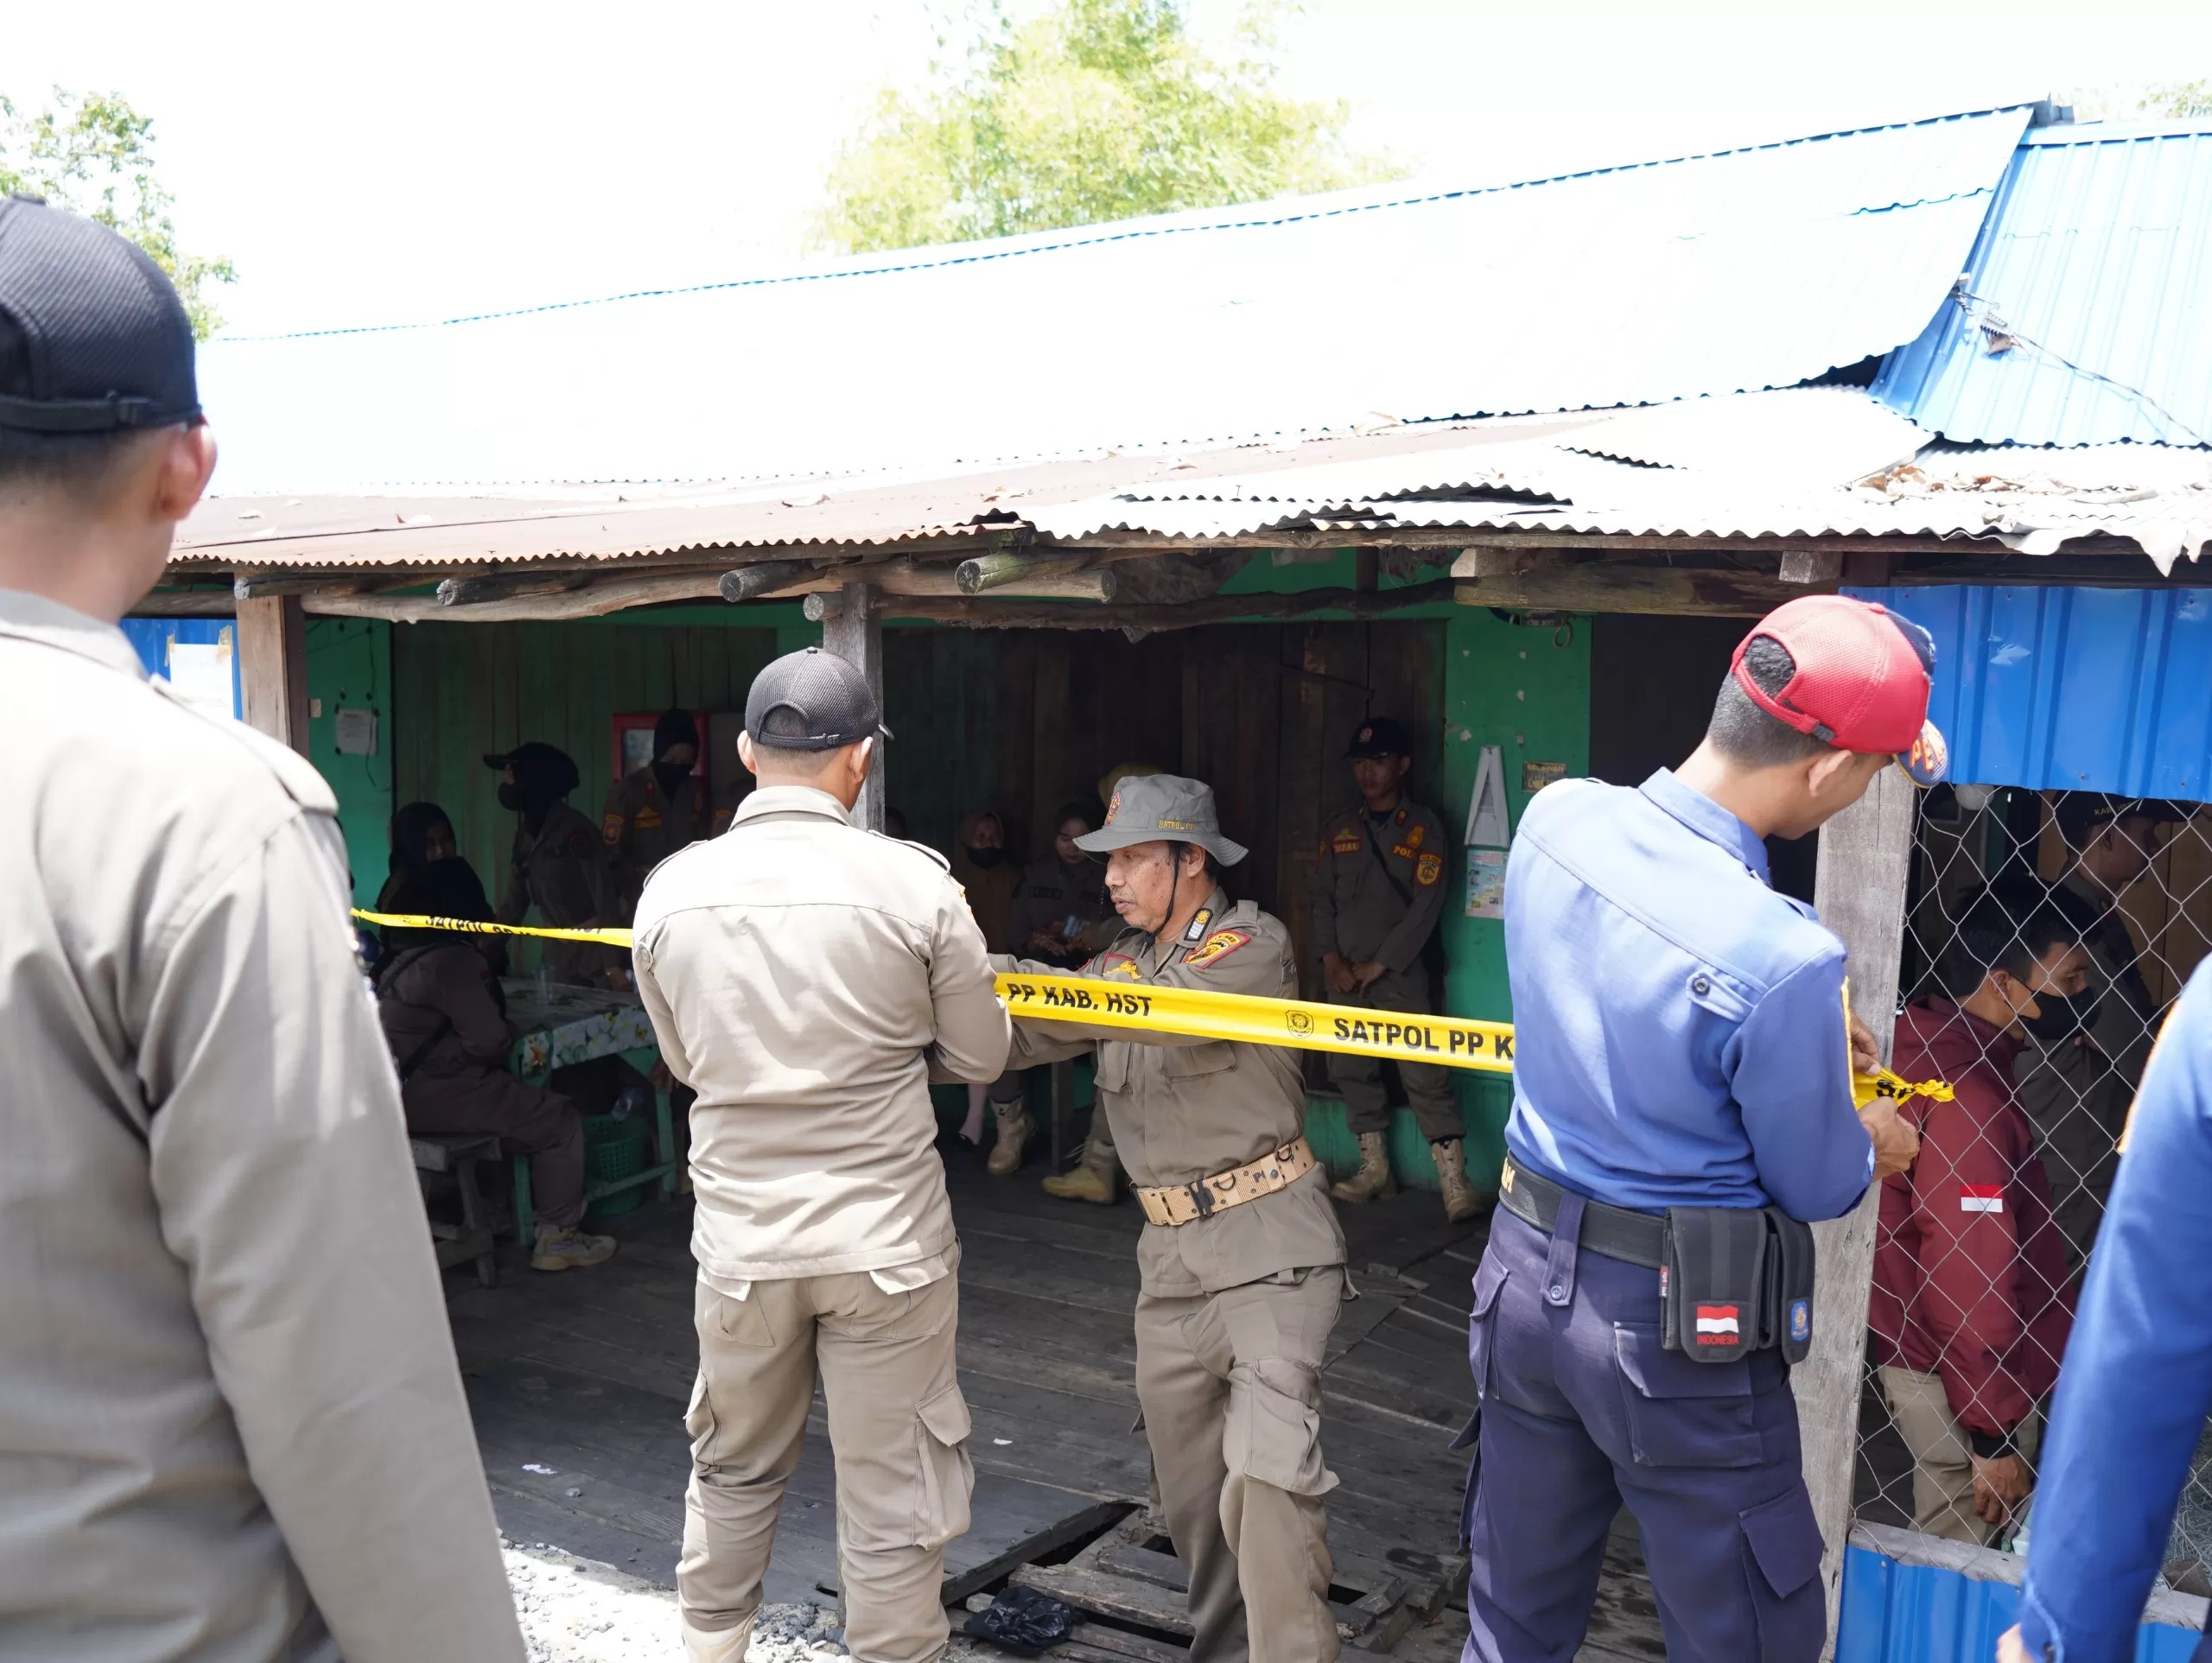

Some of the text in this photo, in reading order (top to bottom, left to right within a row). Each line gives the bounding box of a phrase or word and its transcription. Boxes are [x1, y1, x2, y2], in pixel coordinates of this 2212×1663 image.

[1159, 821, 1185, 829] SATPOL
[1007, 983, 1036, 1002] PP
[1042, 986, 1099, 1010] KAB.
[1105, 993, 1152, 1016] HST
[1333, 1018, 1440, 1052] SATPOL
[1449, 1030, 1484, 1057] PP
[1696, 1334, 1738, 1345] INDONESIA
